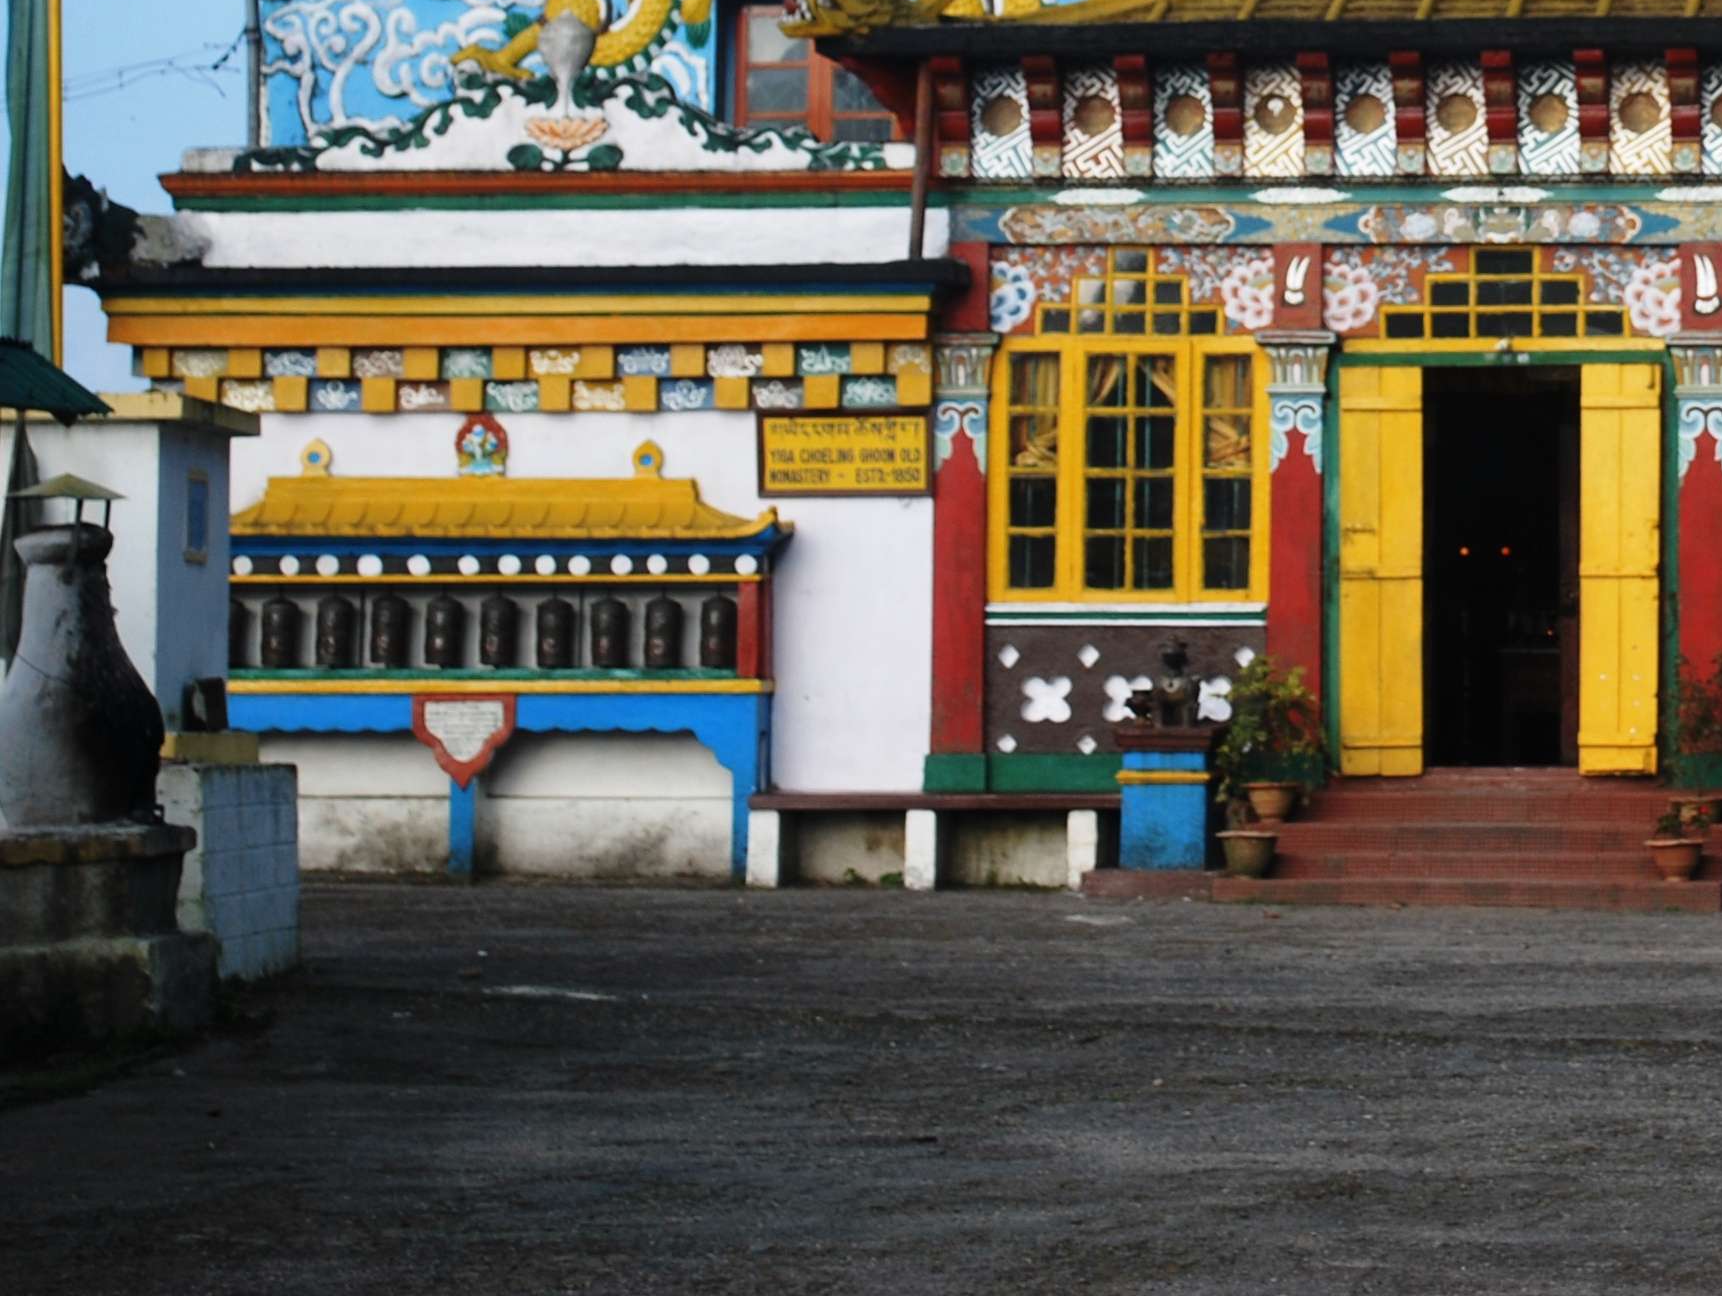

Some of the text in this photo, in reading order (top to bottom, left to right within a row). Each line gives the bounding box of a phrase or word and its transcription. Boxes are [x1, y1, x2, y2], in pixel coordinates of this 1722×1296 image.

[799, 447, 854, 463] CHOELING
[899, 447, 921, 463] OLD
[769, 467, 831, 484] MONASTERY
